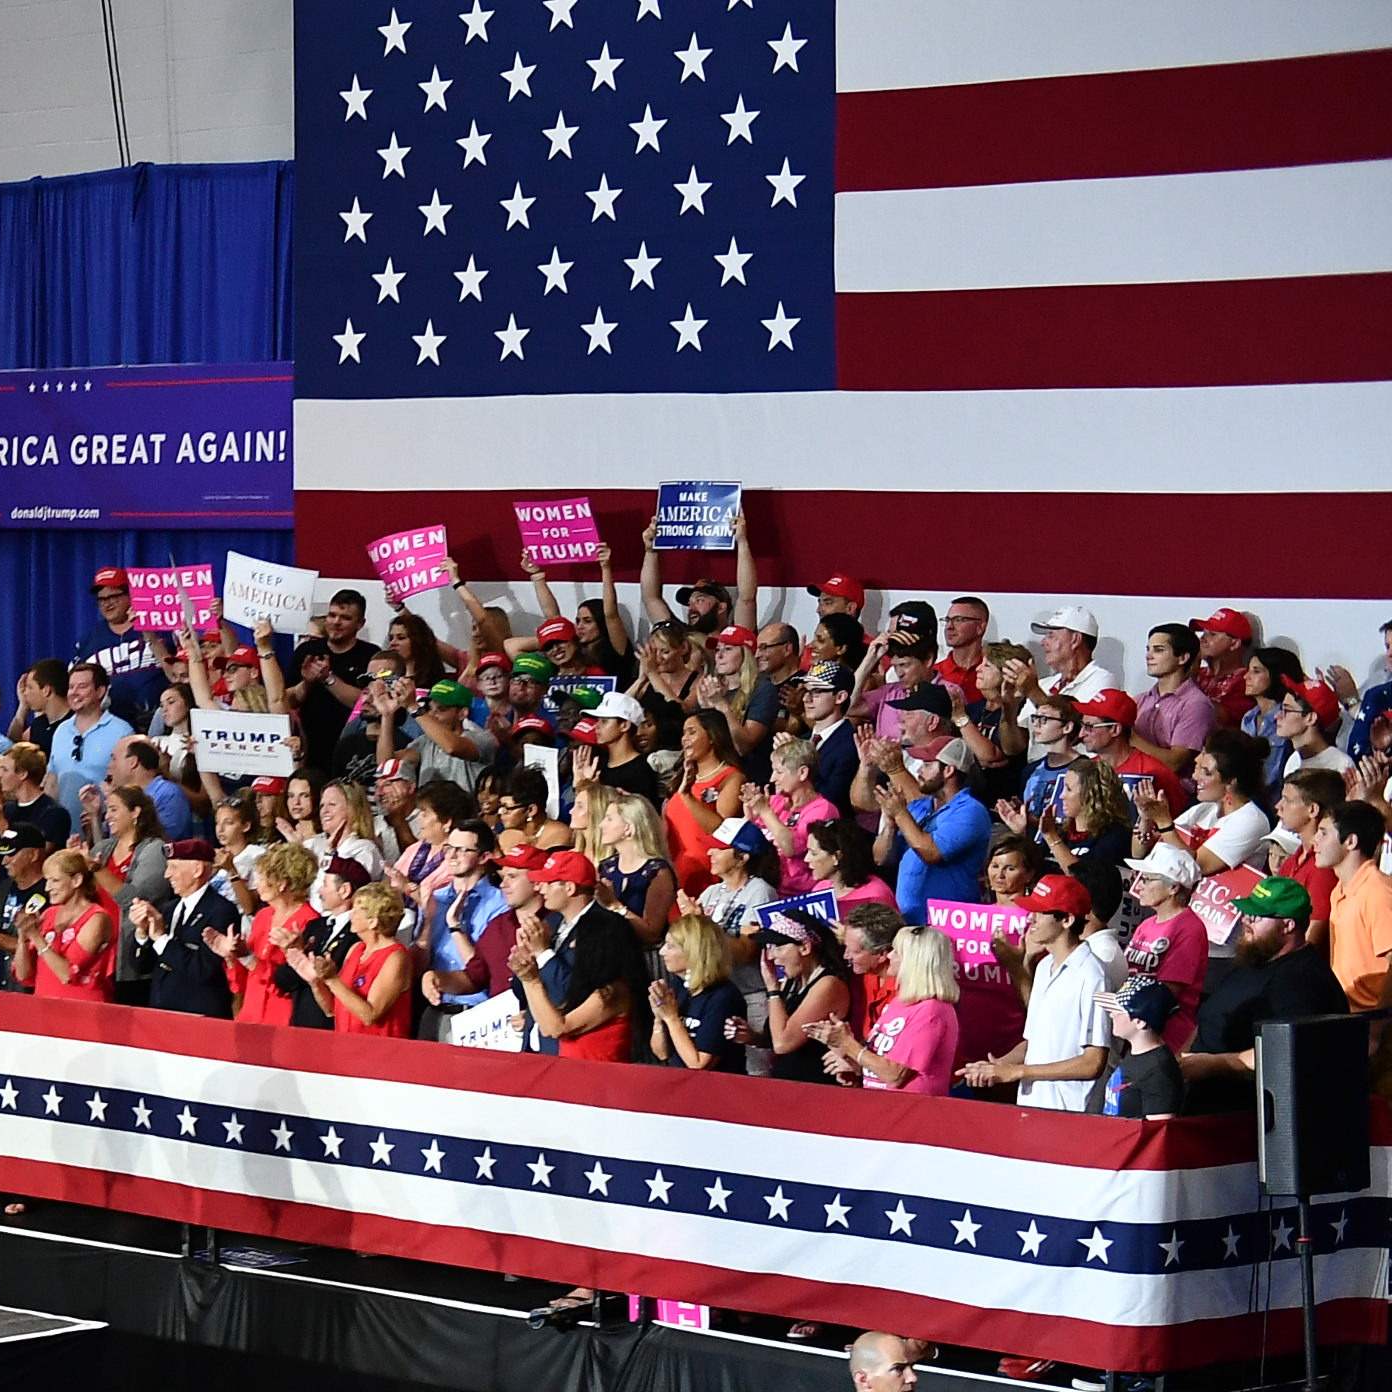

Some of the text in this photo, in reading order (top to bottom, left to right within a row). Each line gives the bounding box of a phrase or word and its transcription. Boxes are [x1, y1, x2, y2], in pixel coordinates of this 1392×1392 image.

[70, 433, 165, 465] GREAT
[177, 430, 287, 463] AGAIN!
[679, 491, 708, 503] MAKE
[10, 505, 99, 521] donaldjtrump.com
[517, 503, 592, 523] WOMEN
[657, 503, 735, 524] AMERICA
[541, 526, 568, 539] FOR
[655, 524, 733, 537] STRONG AGAIN
[368, 526, 446, 563] WOMEN
[528, 542, 598, 562] TRUMP
[389, 556, 415, 573] FOR
[128, 569, 212, 590] WOMEN
[251, 571, 282, 586] KEEP
[227, 582, 308, 610] AMERICA
[202, 729, 282, 744] TRUMP
[210, 743, 275, 754] PENCE
[928, 906, 1025, 932] WOMEN
[956, 937, 991, 954] FOR
